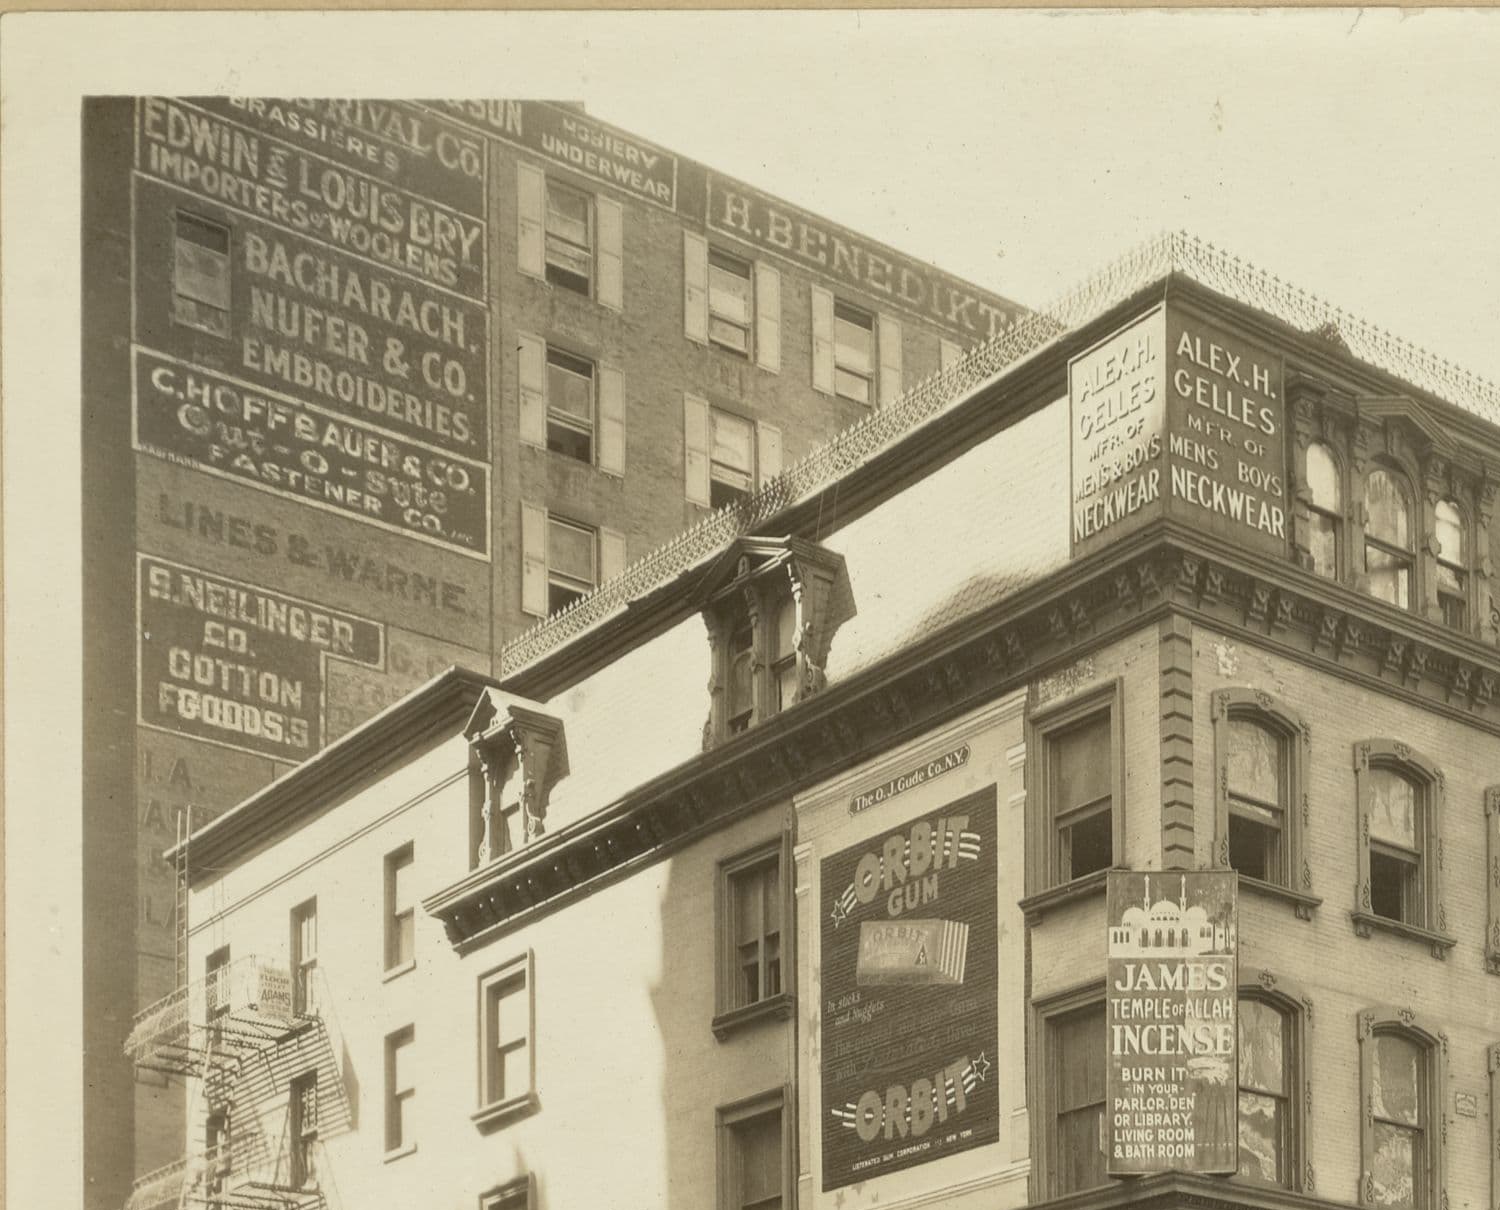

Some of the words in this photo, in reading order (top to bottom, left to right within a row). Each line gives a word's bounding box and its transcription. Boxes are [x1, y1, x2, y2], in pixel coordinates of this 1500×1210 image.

[144, 101, 258, 179] EDWIN
[300, 157, 405, 233] LOUIS
[409, 201, 481, 262] BRY
[542, 133, 672, 201] UNDERWEAR
[150, 141, 310, 230] IMPORTERS
[329, 213, 459, 286] WOOLENS
[249, 288, 369, 365] NUFER
[383, 340, 412, 381] &
[422, 348, 476, 402] CO.
[242, 338, 477, 446] EMBROIDERIES.
[1080, 376, 1156, 441] GELLES
[1175, 368, 1275, 435] GELLES
[1126, 418, 1145, 439] OF
[1244, 439, 1266, 458] OF
[208, 444, 383, 514] FASTENER
[1111, 465, 1125, 483] &
[1073, 467, 1161, 544] NECKWEAR
[1171, 463, 1286, 539] NECKWEAR
[158, 493, 278, 555] LINES
[286, 532, 322, 567] &
[855, 793, 876, 812] The
[854, 814, 971, 905] ORBIT
[887, 872, 939, 917] GUM
[260, 988, 291, 1007] ADAMS
[1114, 962, 1229, 992] JAMES
[1111, 998, 1171, 1020] TEMPLE
[1184, 998, 1234, 1020] ALLAH
[1111, 1024, 1233, 1057] INCENSE
[1121, 1066, 1166, 1082] BURN
[1169, 1066, 1185, 1082] IT
[854, 1054, 971, 1143] ORBIT
[1113, 1113, 1131, 1127] OR
[1169, 1097, 1195, 1112] DEN
[1113, 1143, 1126, 1159] &
[1125, 1143, 1155, 1159] BATH
[1157, 1143, 1195, 1159] ROOM
[1114, 1128, 1155, 1143] LIVING
[1157, 1128, 1195, 1143] ROOM
